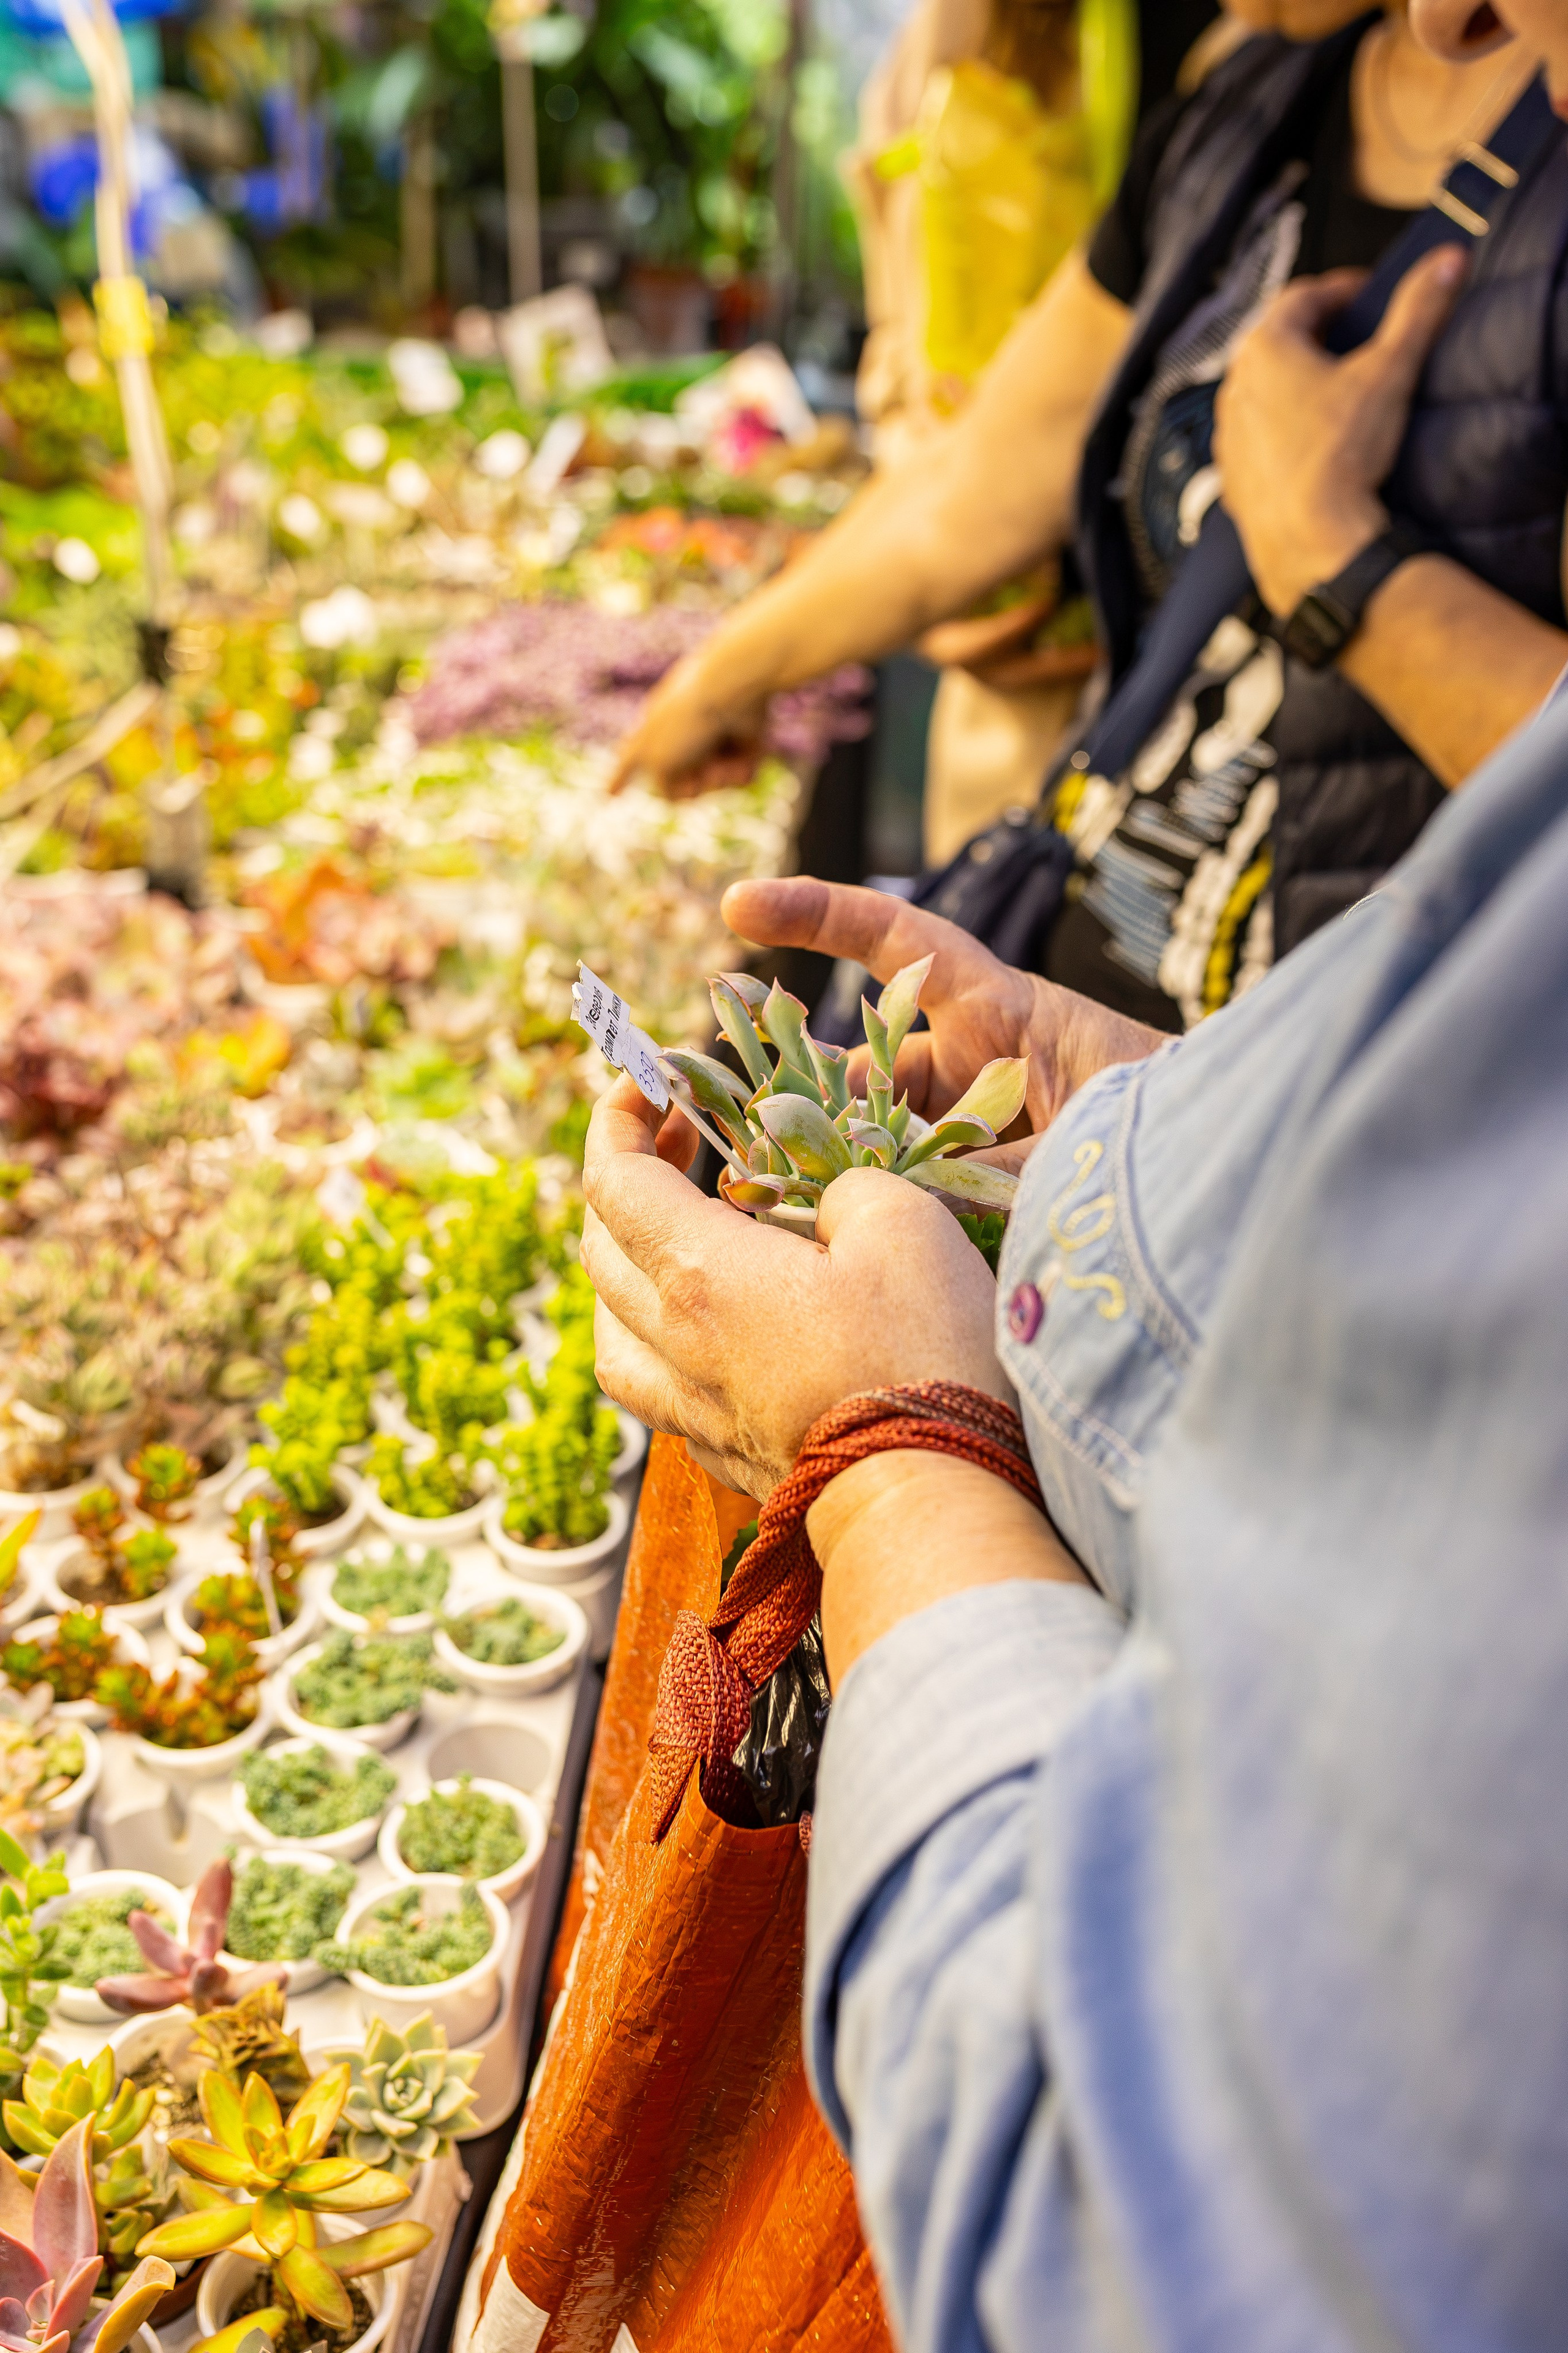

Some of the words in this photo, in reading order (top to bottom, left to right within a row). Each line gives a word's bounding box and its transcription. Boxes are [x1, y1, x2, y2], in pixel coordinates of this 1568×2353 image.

[608, 994, 622, 1021] Пинки
[601, 1019, 619, 1062] Трампет
[639, 1051, 655, 1092] 350
